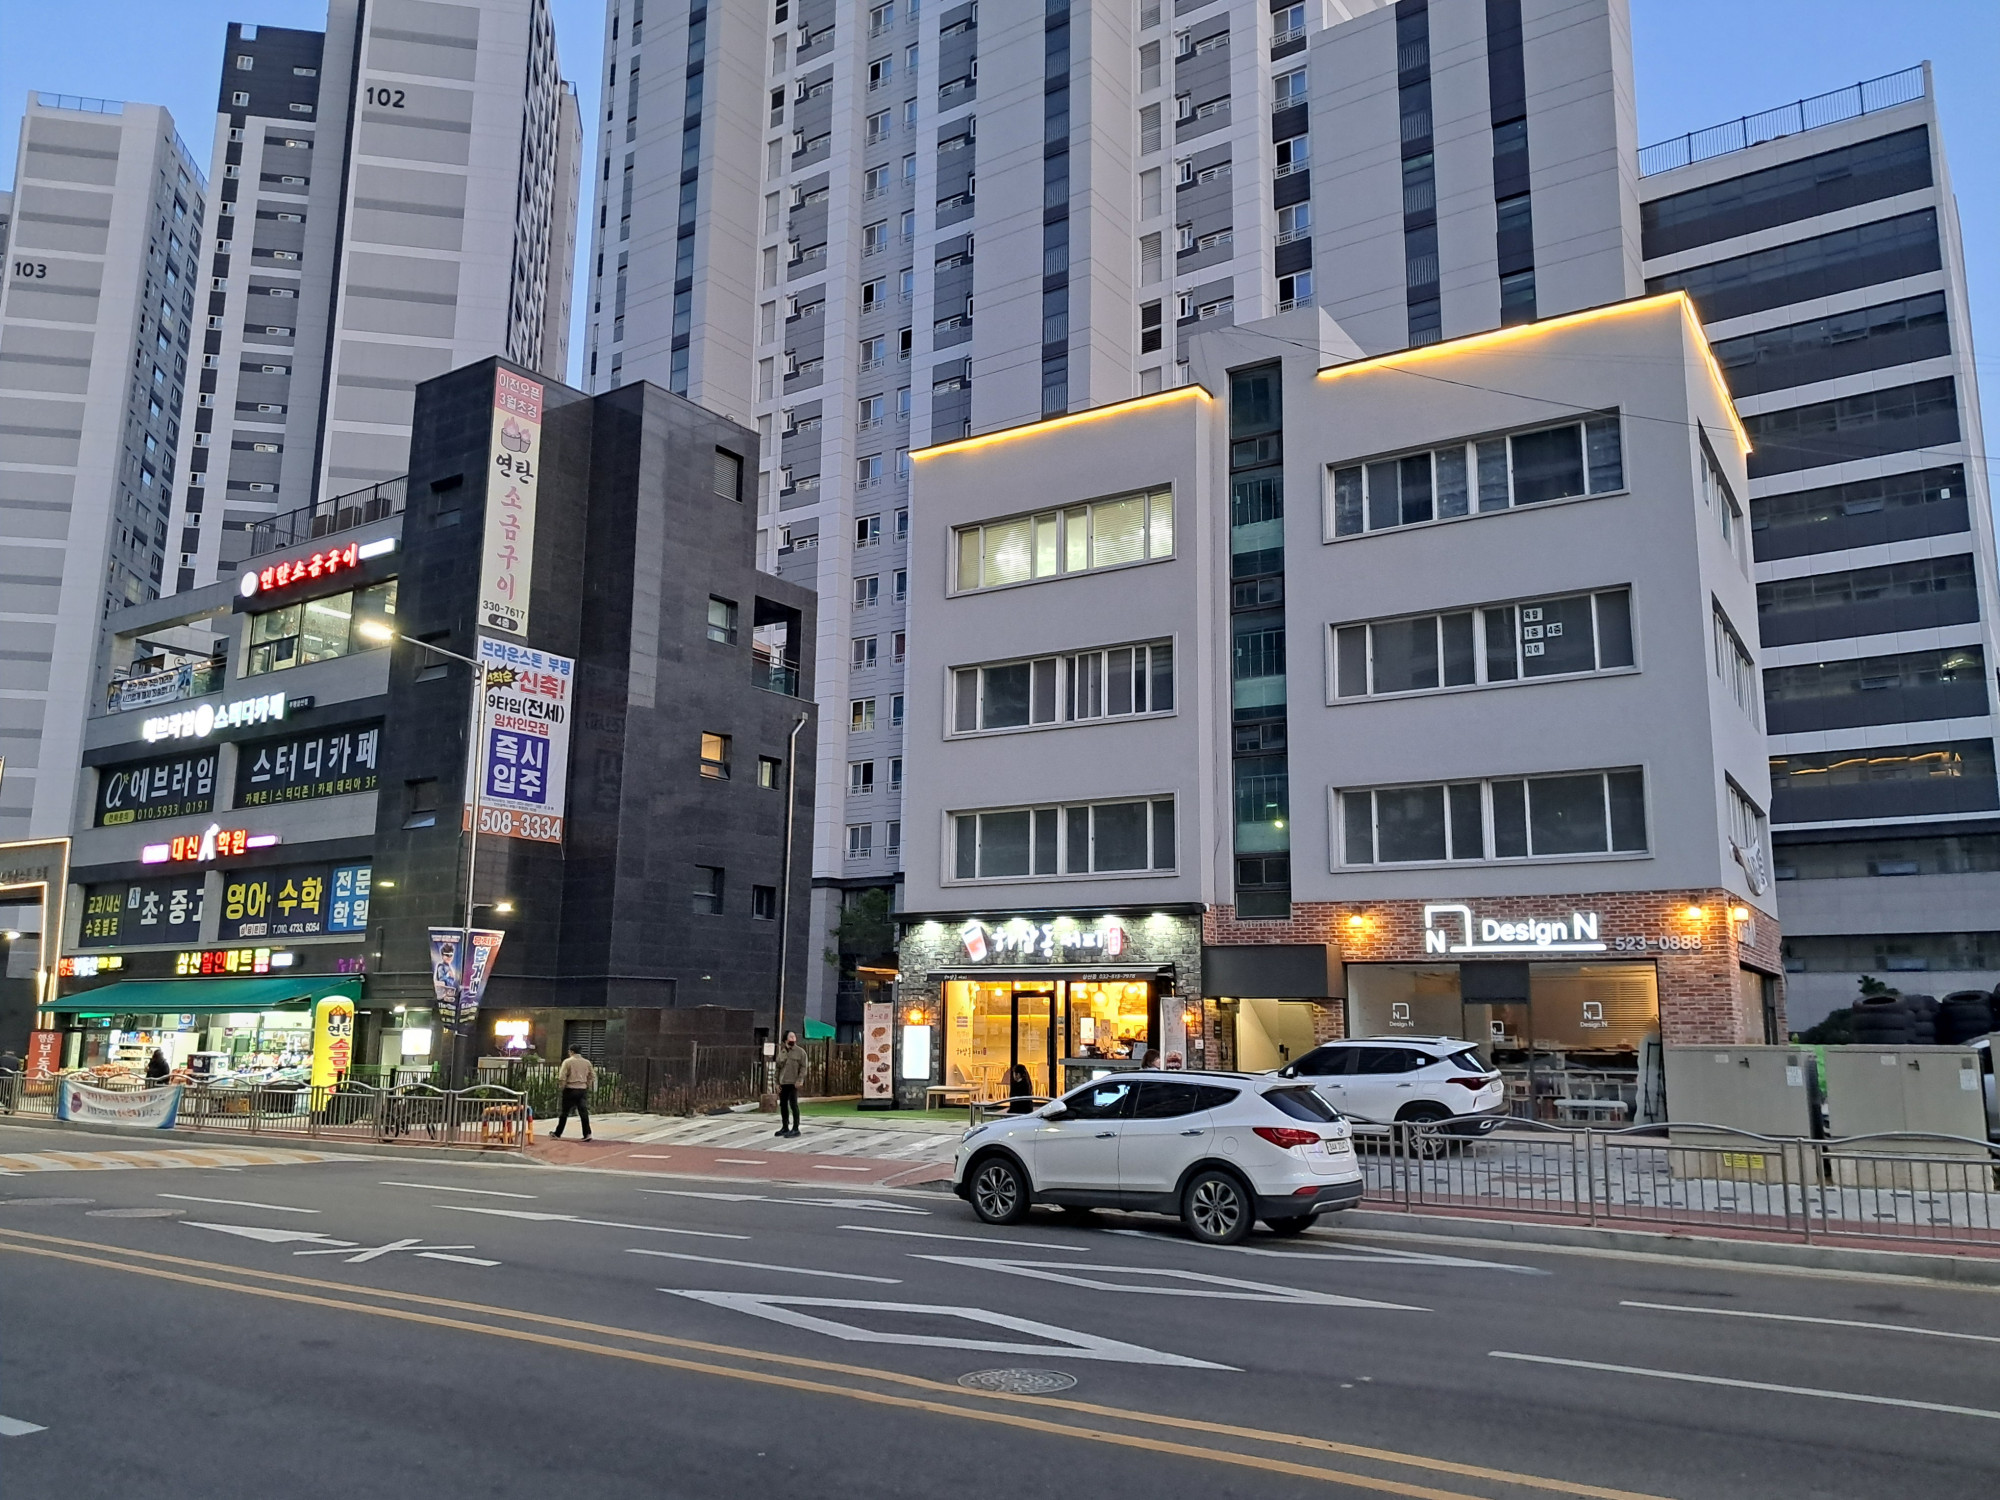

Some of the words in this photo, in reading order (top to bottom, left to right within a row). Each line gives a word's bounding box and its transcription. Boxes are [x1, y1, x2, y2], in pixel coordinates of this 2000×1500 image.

[366, 86, 405, 109] 102
[14, 262, 47, 279] 103
[499, 373, 541, 402] 이전오픈
[498, 391, 537, 419] 3월초경
[496, 452, 535, 485] 연탄
[496, 484, 523, 602] 소금구이
[259, 542, 358, 591] 연탄소금구이
[482, 599, 525, 620] 330-7617
[482, 639, 543, 670] 브라운스톤
[547, 657, 572, 676] 부평
[1526, 645, 1540, 654] 지하
[519, 670, 566, 700] 신축!
[494, 713, 549, 736] 임차인모집
[251, 729, 379, 783] 스터디카페
[495, 734, 544, 769] 즉시
[130, 756, 215, 803] 에브라임
[365, 775, 377, 789] 3F
[493, 764, 542, 799] 입주
[137, 800, 209, 820] 010.5933.0191
[172, 835, 199, 861] 대신
[217, 830, 246, 855] 학원
[336, 868, 371, 897] 전문
[88, 894, 122, 914] 교과/내신
[333, 899, 368, 928] 학원
[85, 917, 118, 938] 수준별로
[305, 922, 320, 932] 6054
[1481, 917, 1568, 946] Design
[1573, 912, 1598, 940] N
[1425, 930, 1446, 953] N
[1614, 934, 1703, 951] 523-0888
[176, 949, 253, 975] 삼산할인마트
[1580, 1021, 1601, 1029] Design
